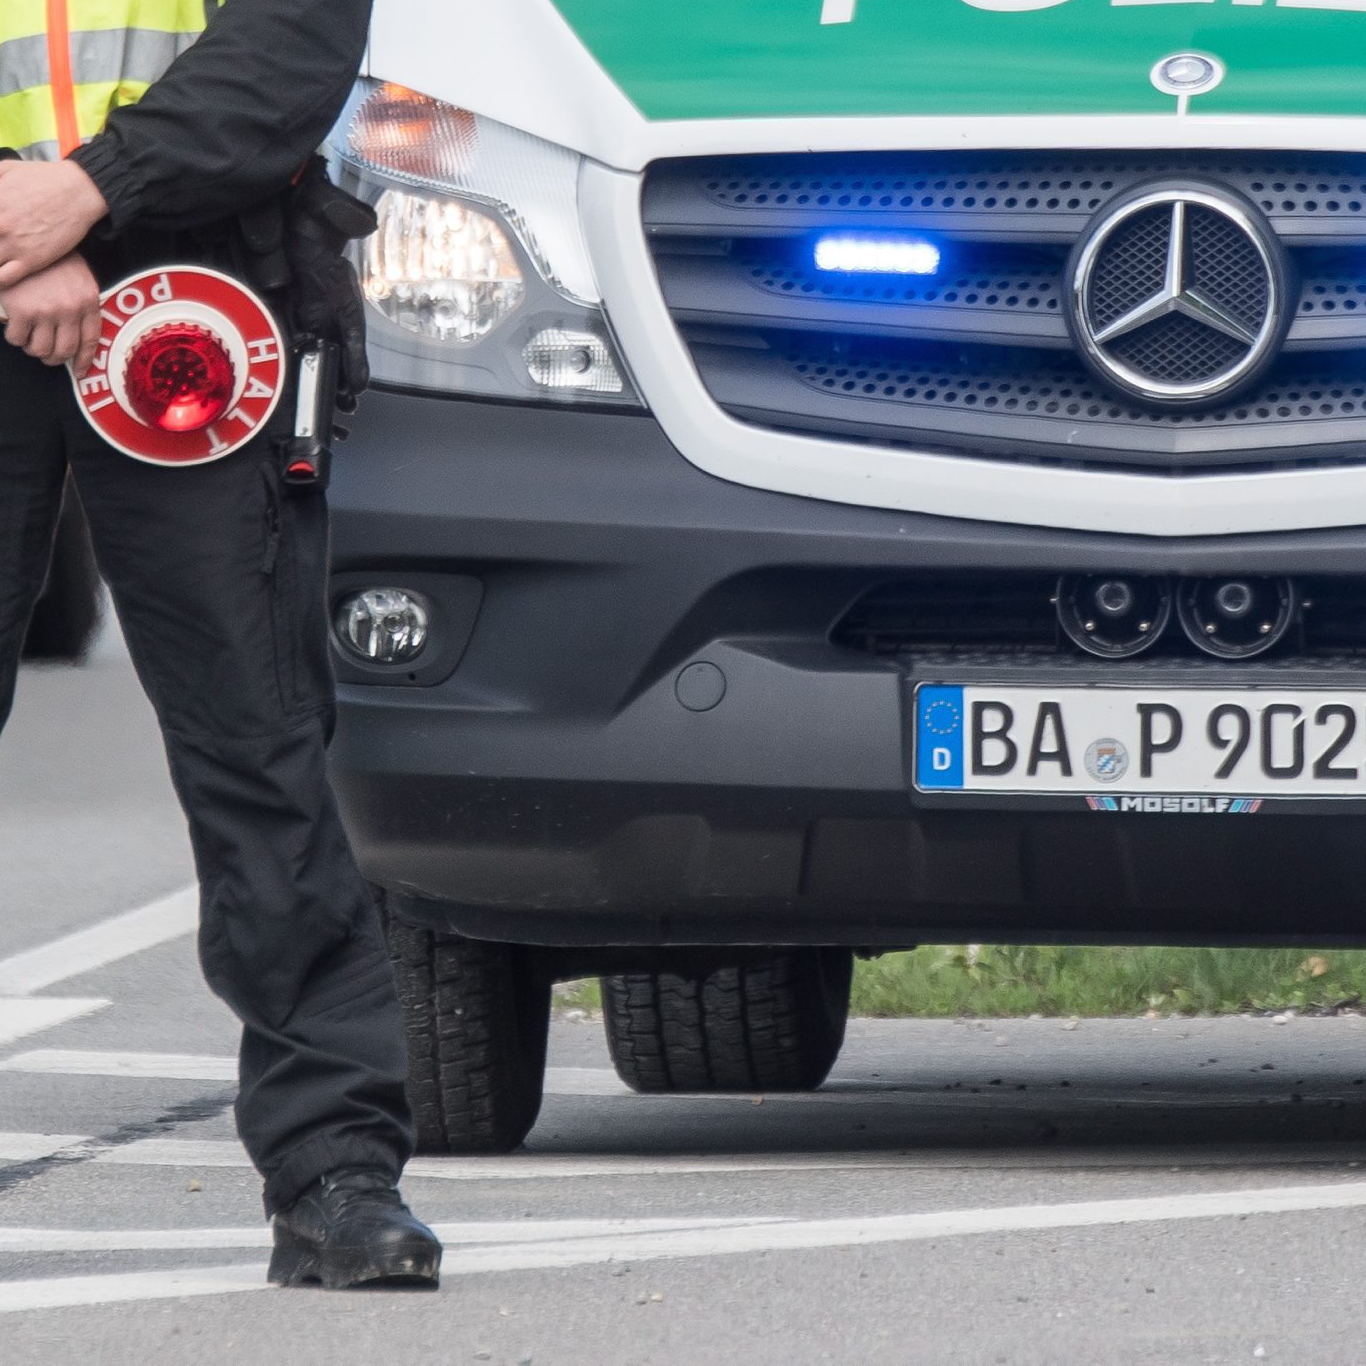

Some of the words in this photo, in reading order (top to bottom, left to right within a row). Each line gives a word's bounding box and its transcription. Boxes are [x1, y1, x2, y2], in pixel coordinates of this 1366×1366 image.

[206, 336, 279, 455] HALT
[932, 747, 952, 771] D
[971, 700, 1073, 778] BA
[1138, 702, 1184, 779] P
[1120, 796, 1230, 814] MOSOLF
